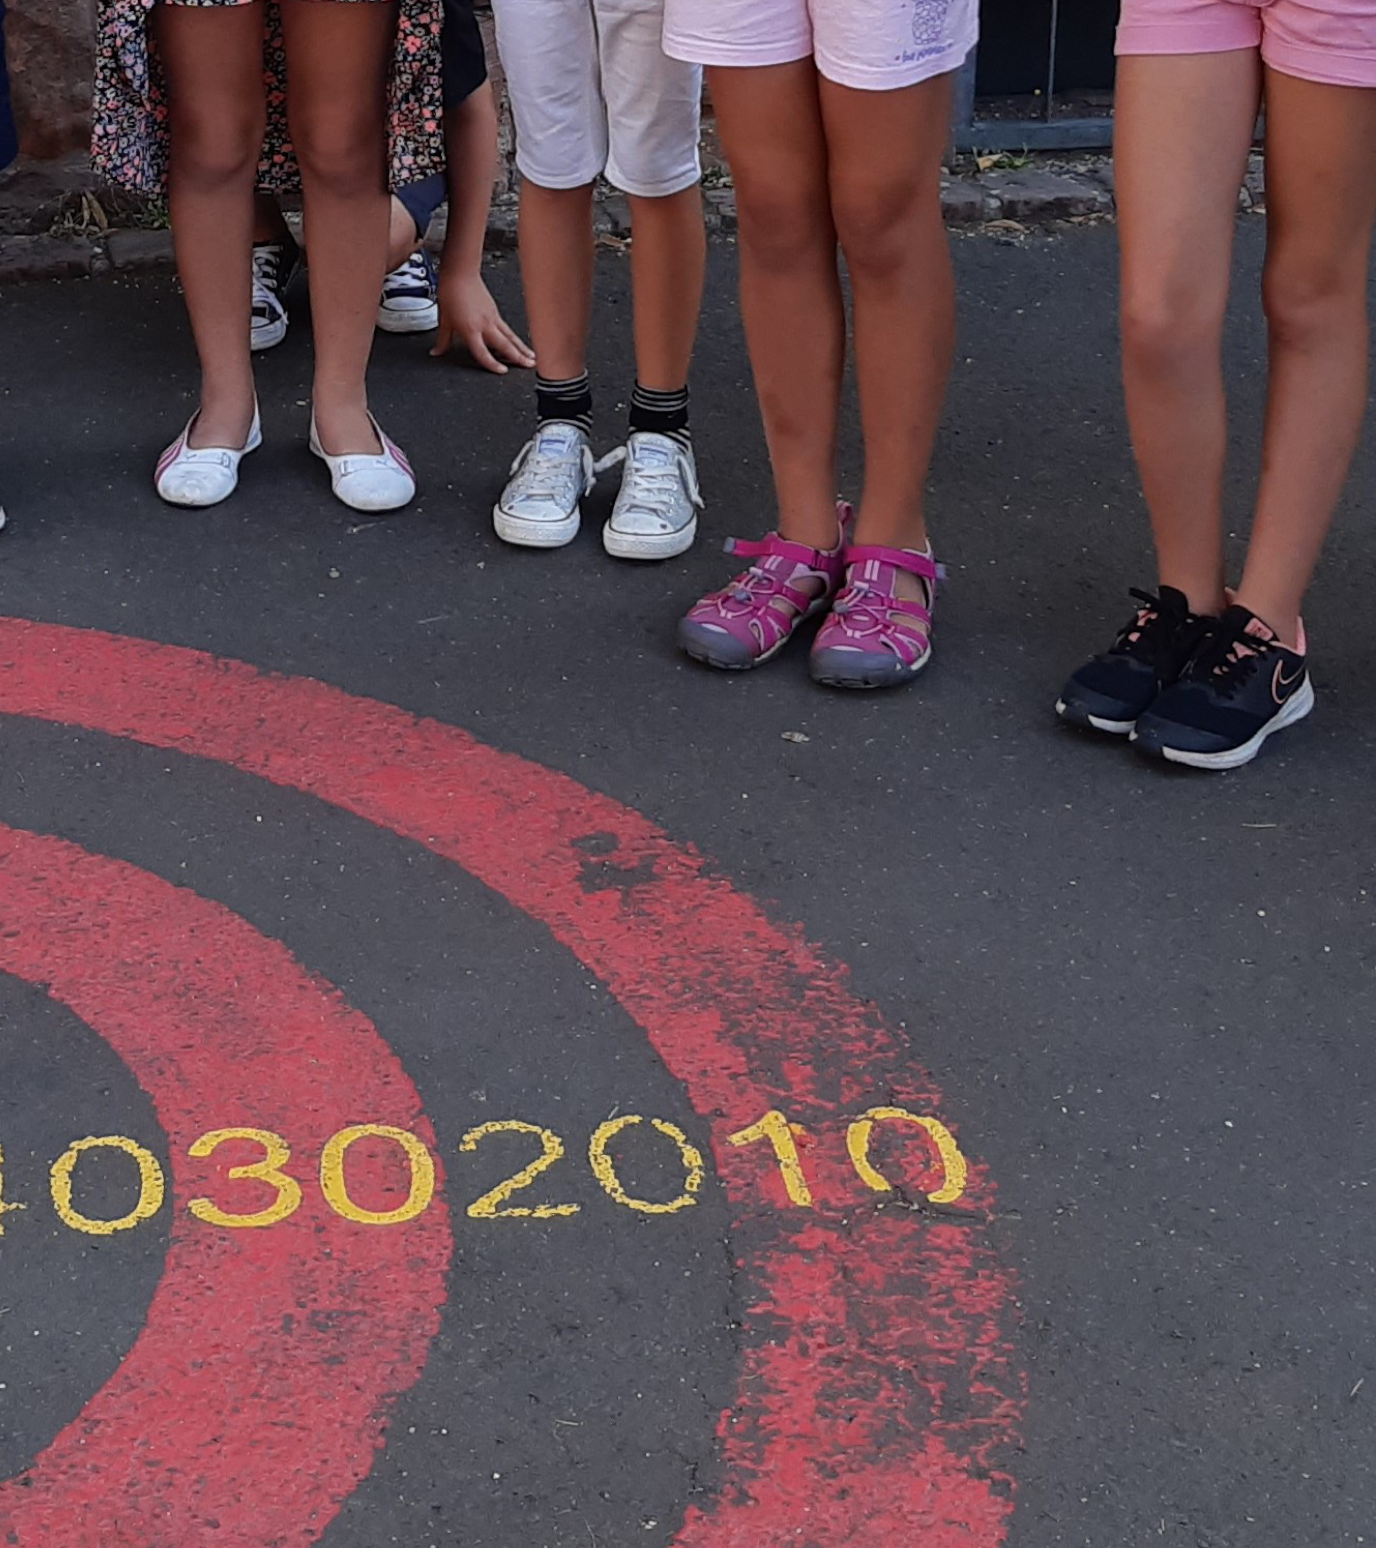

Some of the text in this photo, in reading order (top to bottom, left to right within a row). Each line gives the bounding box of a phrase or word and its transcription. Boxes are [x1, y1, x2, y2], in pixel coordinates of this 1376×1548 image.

[188, 1124, 436, 1228] 30
[459, 1116, 703, 1218] 20
[729, 1107, 968, 1207] 10
